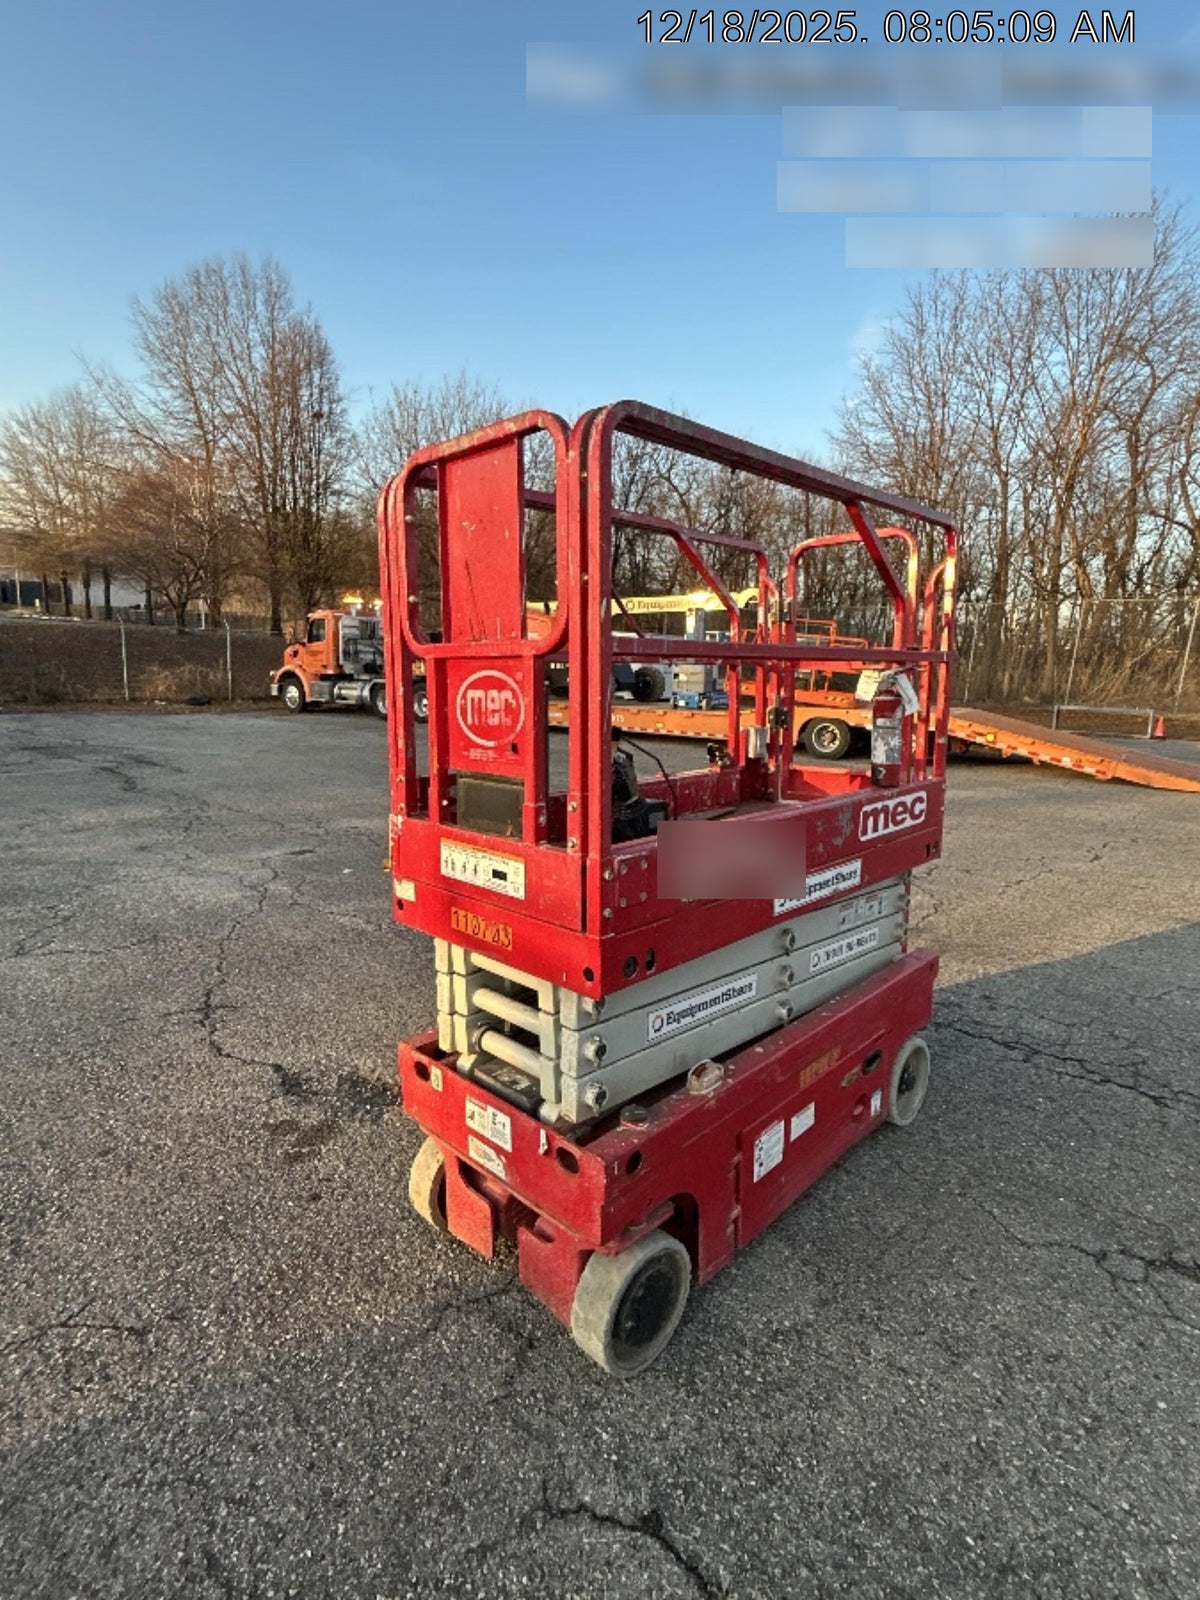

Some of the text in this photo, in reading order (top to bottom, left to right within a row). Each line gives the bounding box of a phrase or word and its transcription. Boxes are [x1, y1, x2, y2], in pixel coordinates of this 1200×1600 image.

[466, 689, 515, 726] mec
[861, 796, 925, 836] mec
[665, 982, 753, 1026] EquipmentShare
